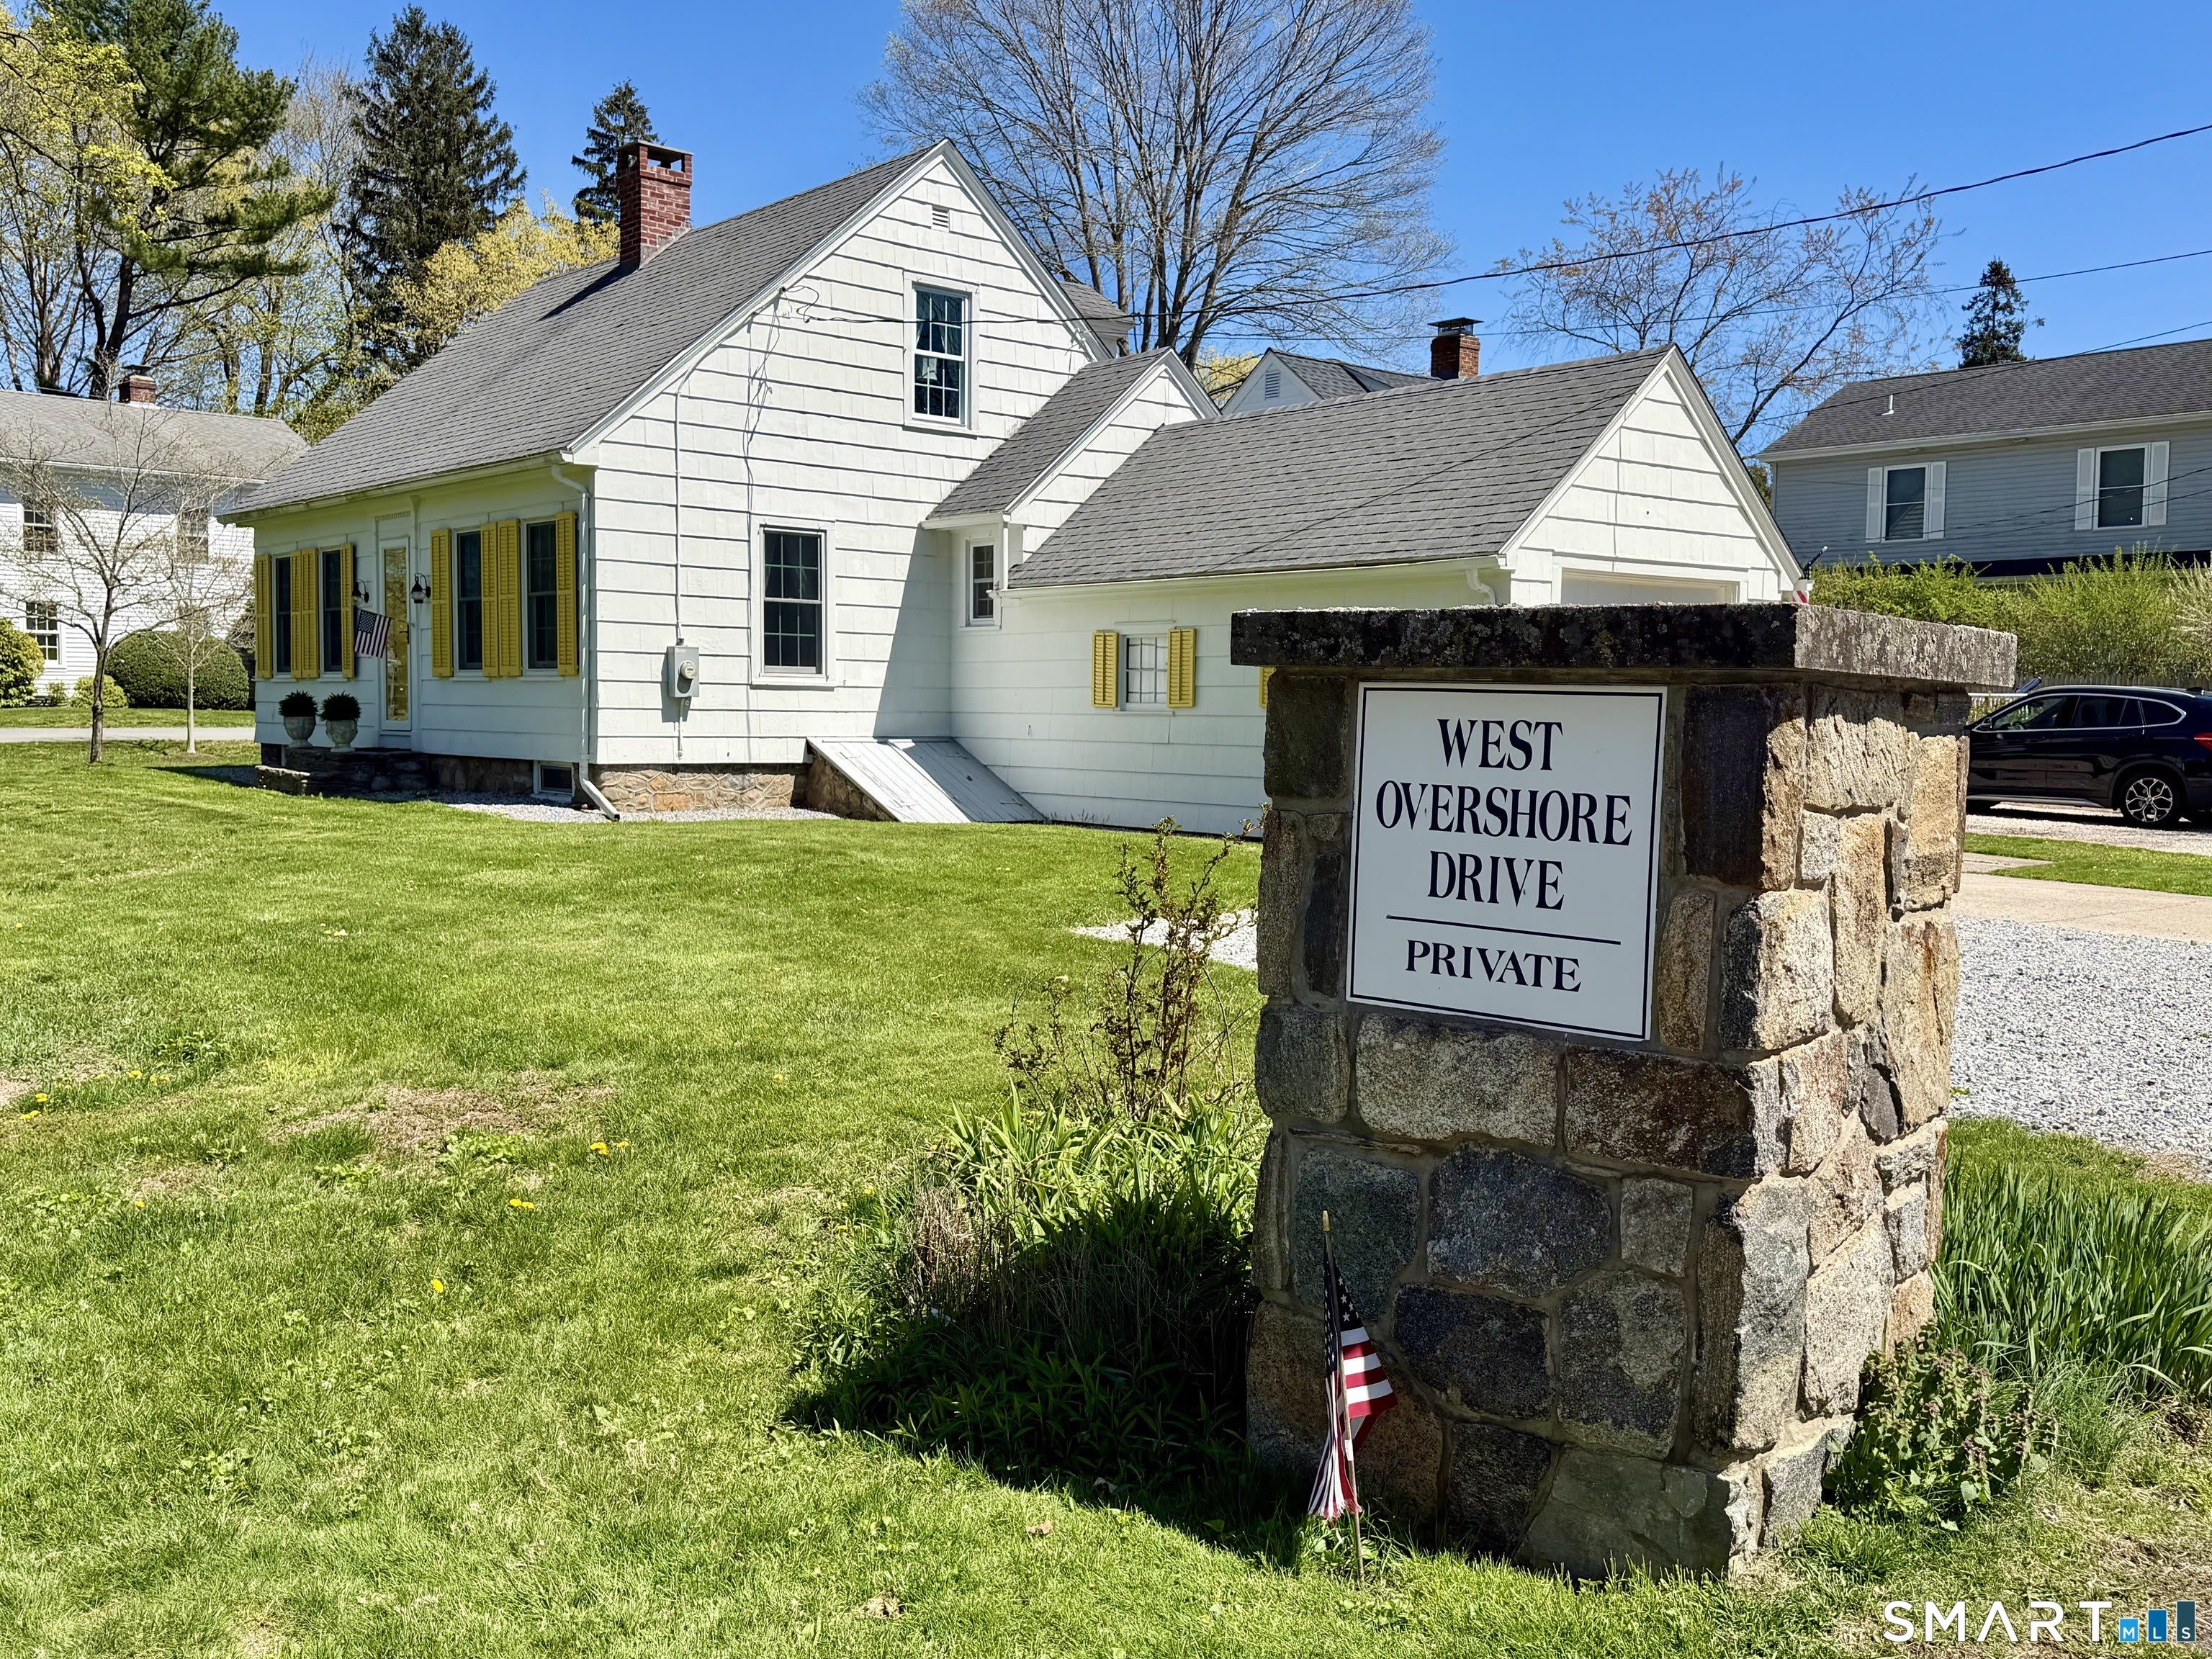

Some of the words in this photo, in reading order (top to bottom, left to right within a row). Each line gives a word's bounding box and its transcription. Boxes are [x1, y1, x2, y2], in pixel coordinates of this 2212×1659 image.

[1437, 717, 1564, 771] WEST
[1376, 780, 1632, 846] OVERSHORE
[1427, 850, 1565, 911] DRIVE
[1405, 939, 1582, 992] PRIVATE
